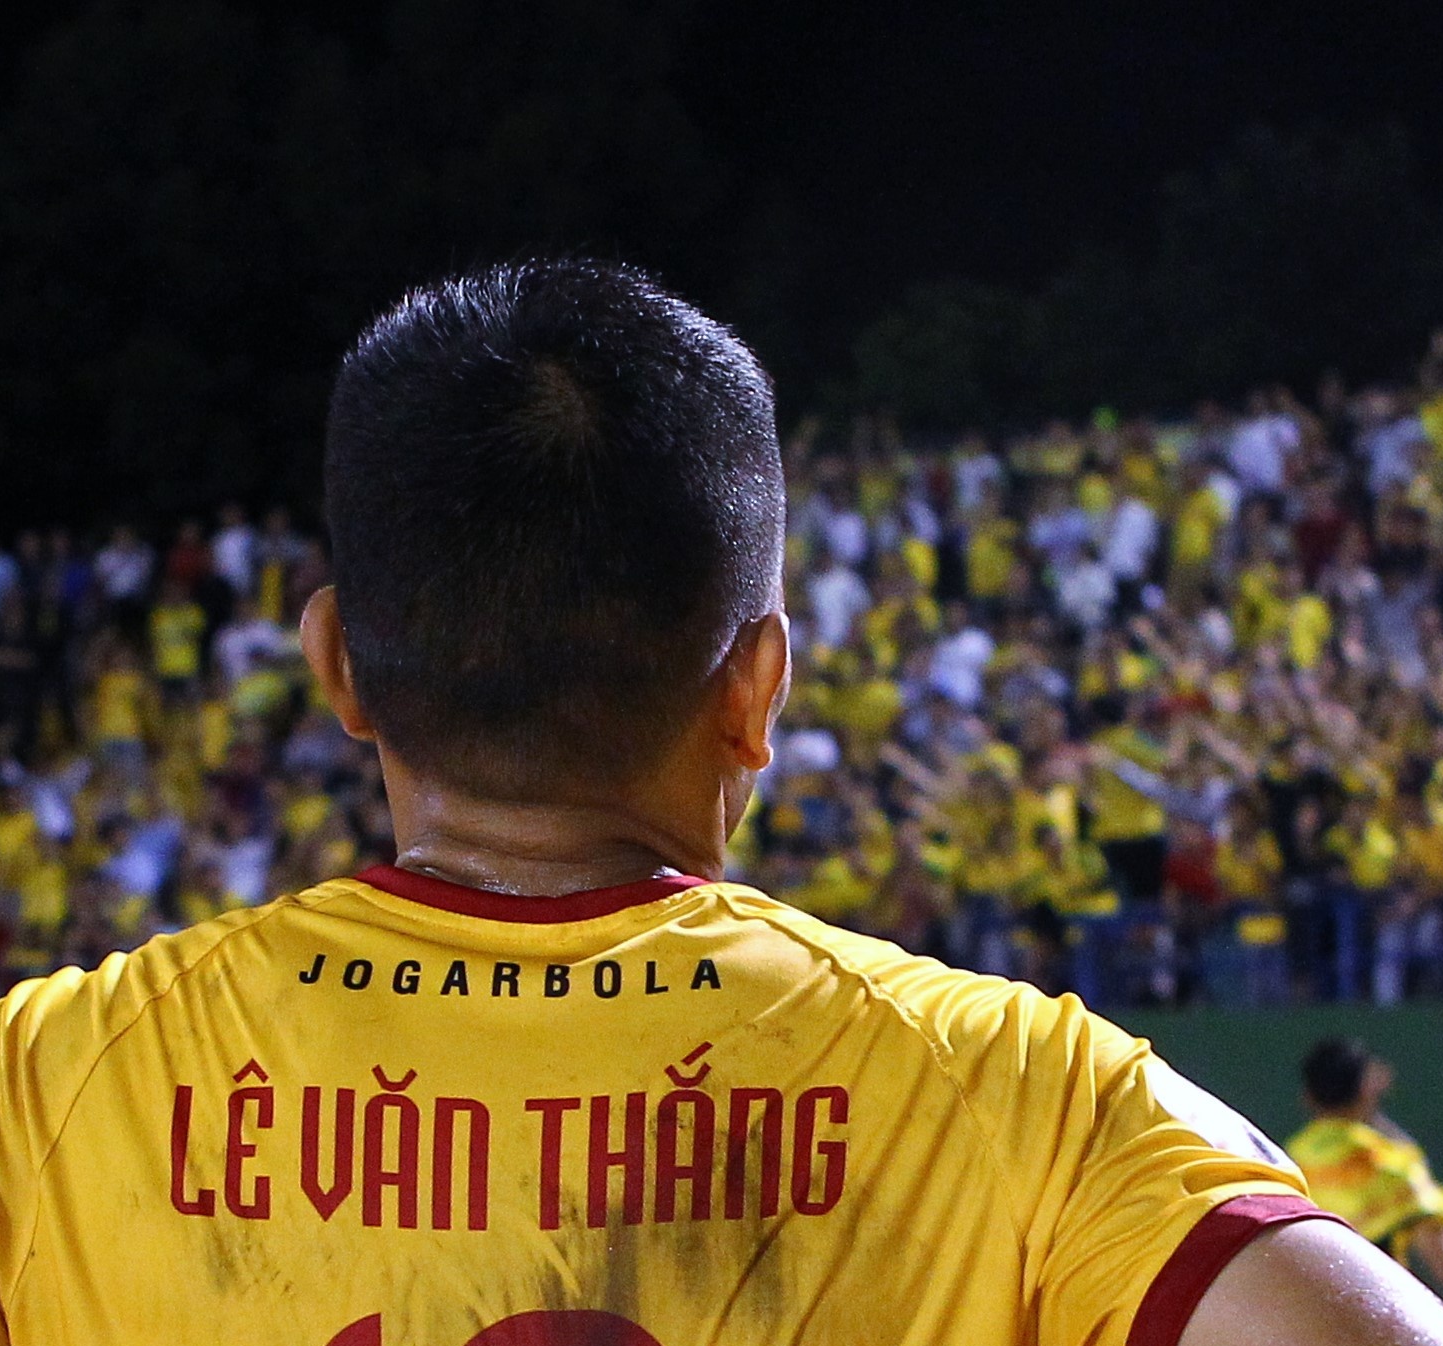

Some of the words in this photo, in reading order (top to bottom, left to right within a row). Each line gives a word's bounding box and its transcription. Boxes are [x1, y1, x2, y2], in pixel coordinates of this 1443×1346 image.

[299, 953, 722, 999] JOGARBOLA
[170, 1058, 275, 1220] LÊ
[300, 1064, 491, 1231] VĂN
[524, 1040, 850, 1231] THẮNG
